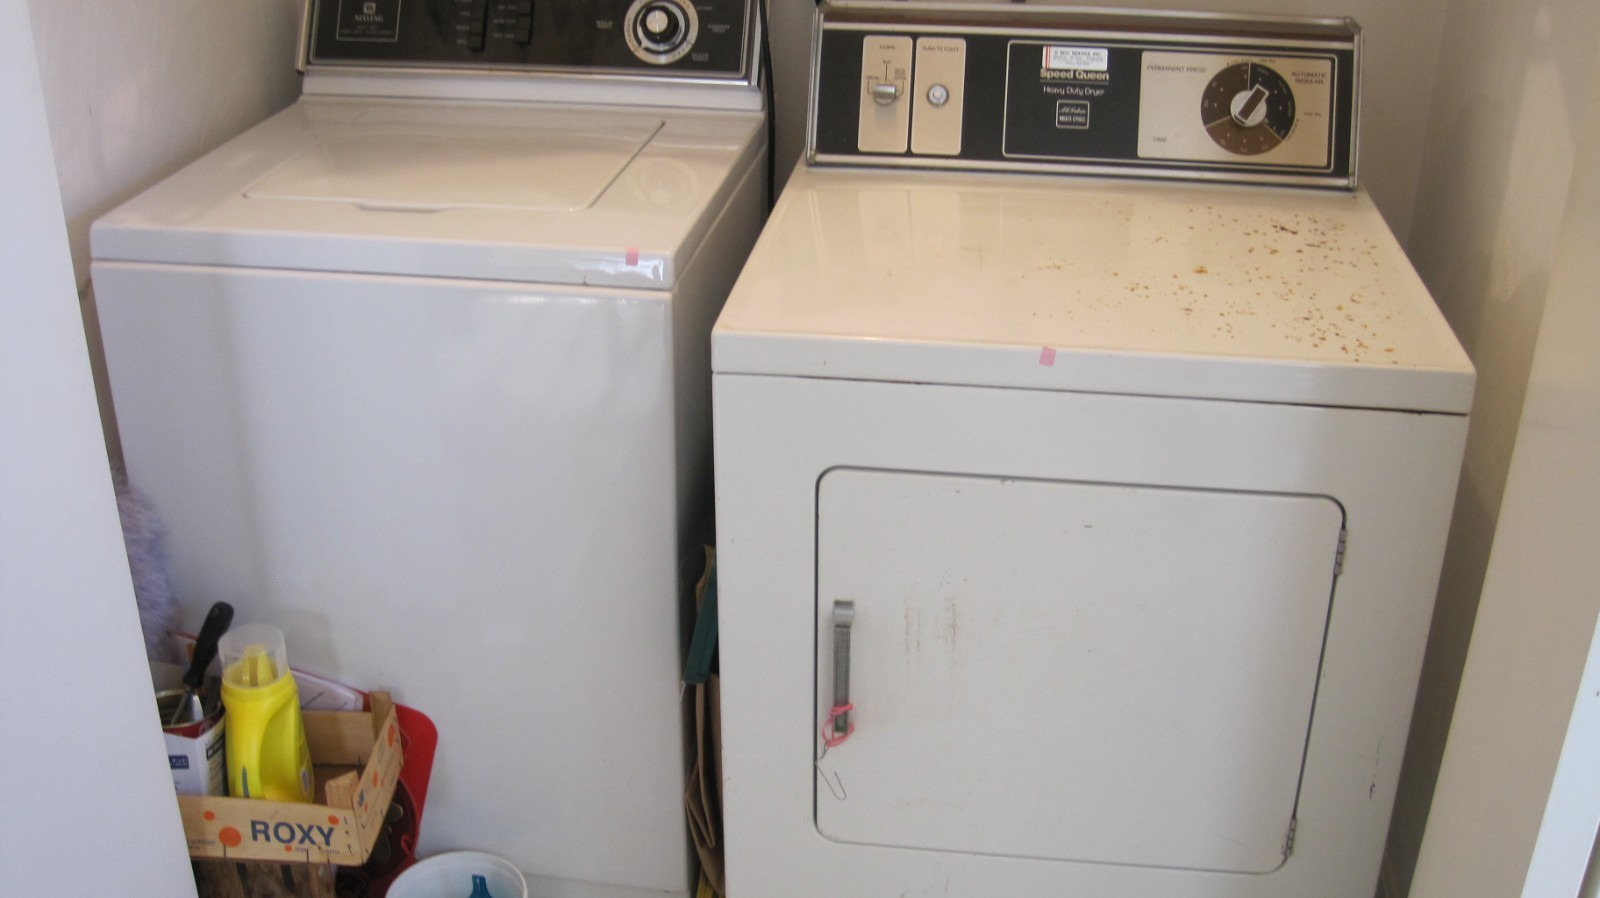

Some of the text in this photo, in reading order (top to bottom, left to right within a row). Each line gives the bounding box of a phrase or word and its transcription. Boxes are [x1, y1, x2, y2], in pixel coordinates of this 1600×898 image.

[354, 14, 384, 23] MAYTAG
[1147, 65, 1185, 73] PERMANENT
[1040, 69, 1109, 80] Speed Queen
[1291, 71, 1327, 79] AUTOMATIC
[1043, 85, 1104, 96] Heavy Duty Dryer
[251, 820, 334, 847] ROXY
